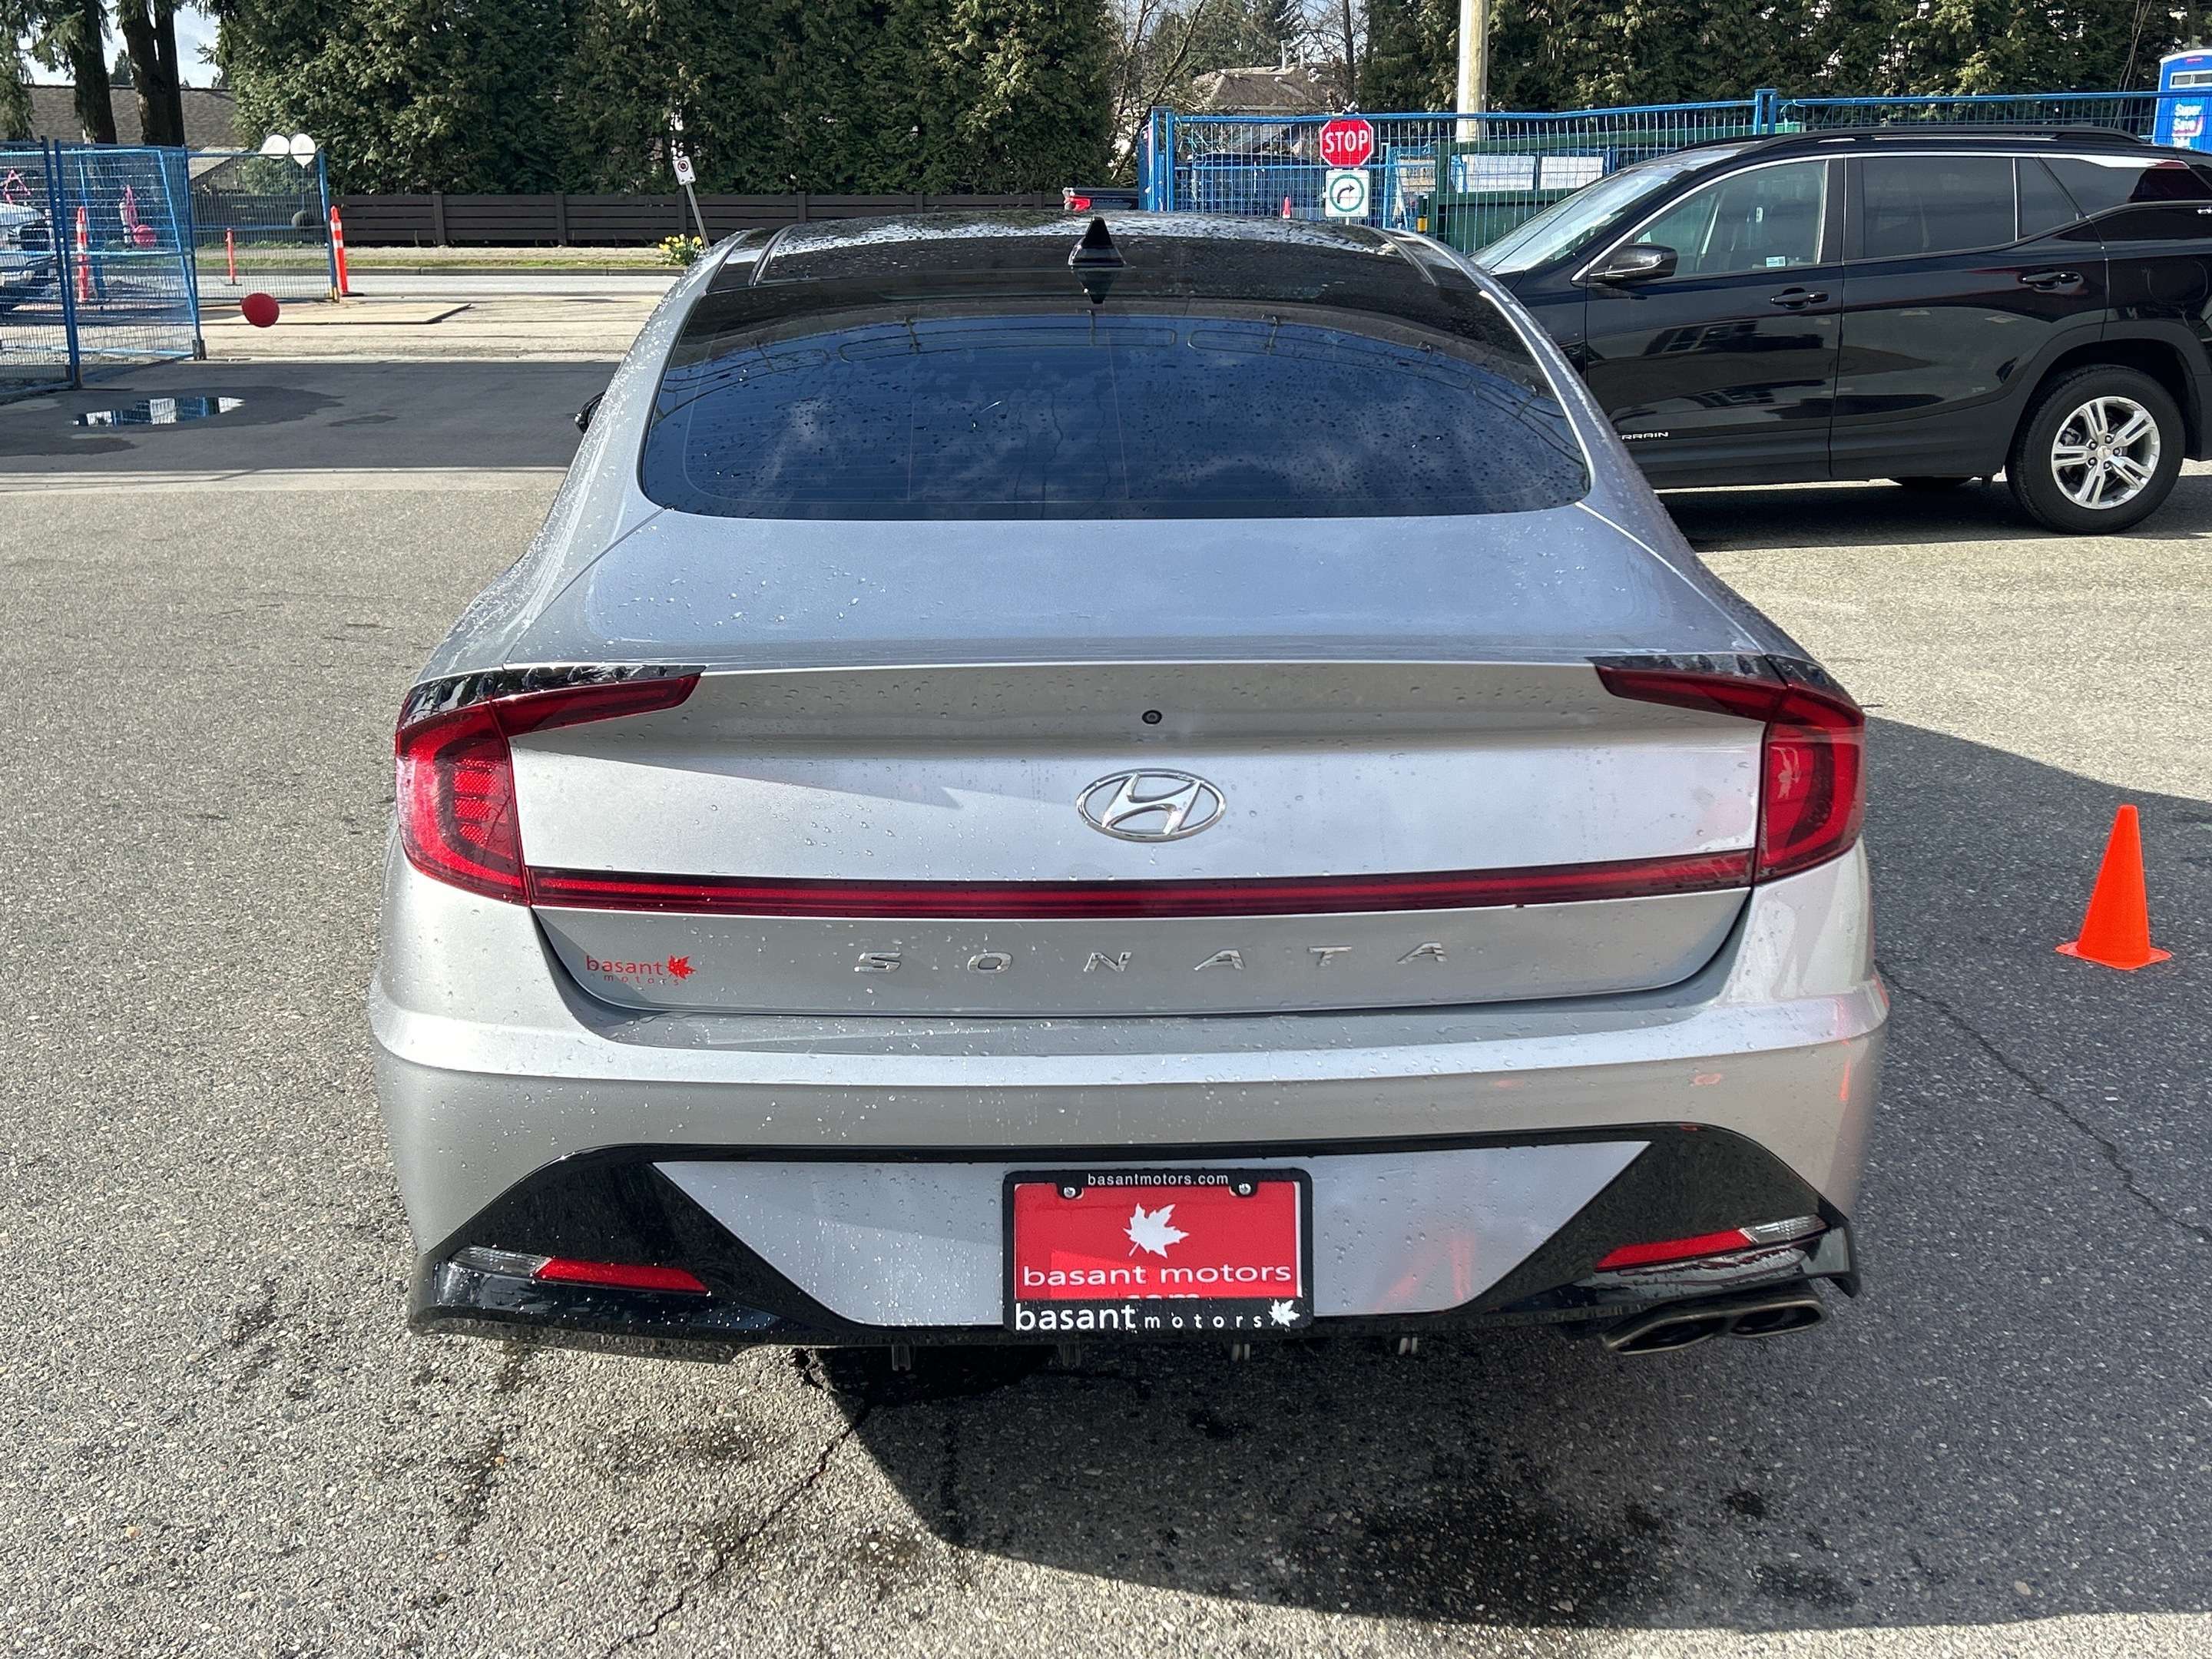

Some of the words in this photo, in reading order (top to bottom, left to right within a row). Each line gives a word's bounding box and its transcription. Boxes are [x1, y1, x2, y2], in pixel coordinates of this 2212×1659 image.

[1325, 129, 1369, 154] STOP
[1621, 432, 1669, 440] RRAIN
[586, 955, 664, 976] basant
[853, 941, 1448, 974] SONATA
[604, 974, 679, 986] motors
[1088, 1173, 1229, 1187] basantmotors.com
[1023, 1265, 1147, 1286] basant
[1161, 1264, 1292, 1284] motors
[1015, 1303, 1137, 1330] basant
[1144, 1311, 1263, 1329] motors
